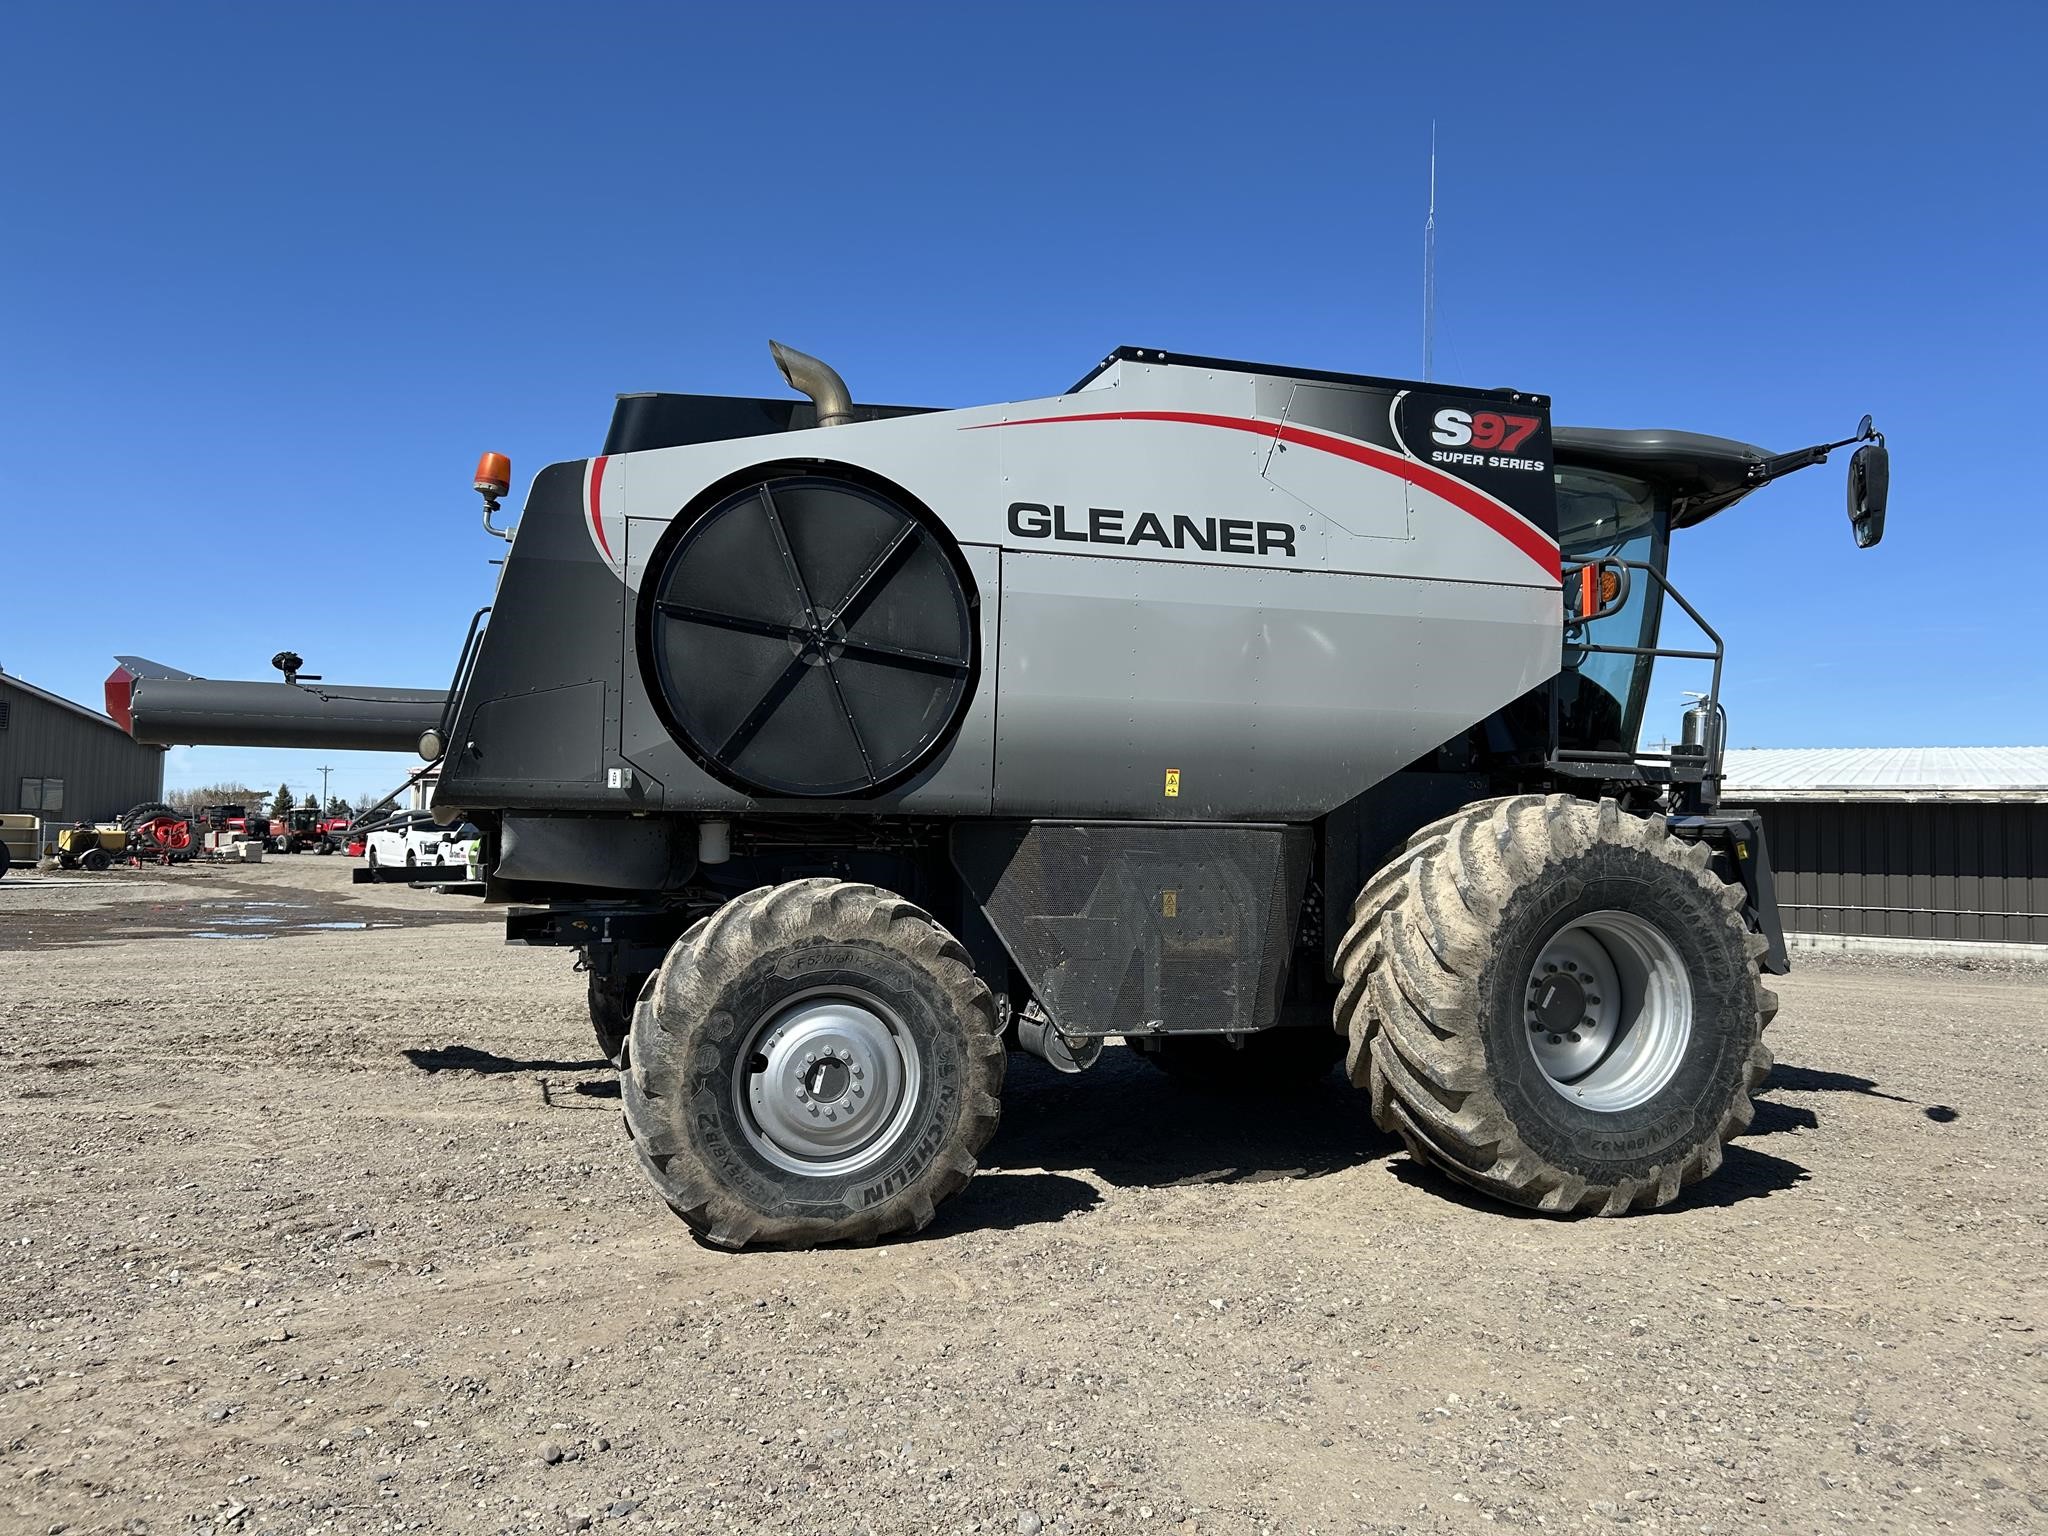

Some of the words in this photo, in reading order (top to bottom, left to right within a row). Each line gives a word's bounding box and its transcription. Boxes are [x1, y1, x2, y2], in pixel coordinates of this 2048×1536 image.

[1431, 408, 1540, 453] S97
[1432, 450, 1484, 466] SUPER
[1488, 456, 1544, 472] SERIES
[1007, 501, 1296, 557] GLEANER
[863, 1085, 954, 1206] MICHELIN
